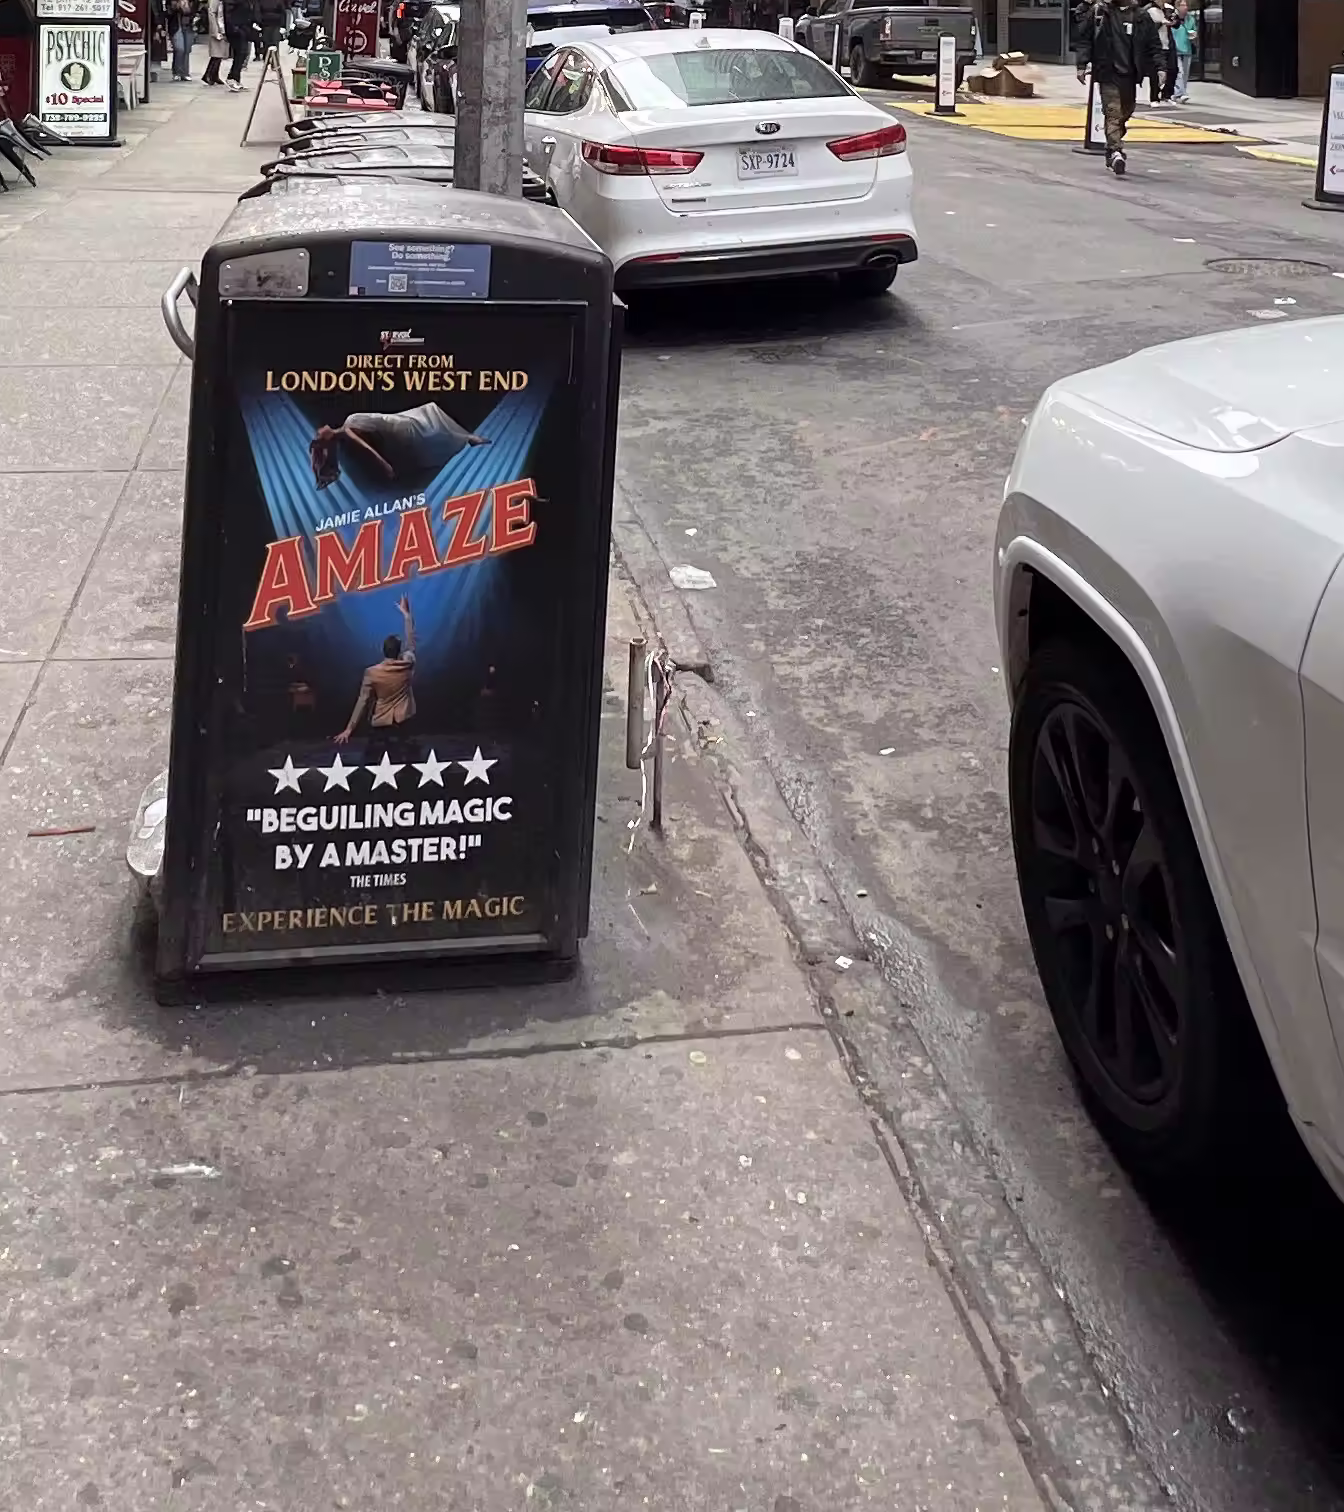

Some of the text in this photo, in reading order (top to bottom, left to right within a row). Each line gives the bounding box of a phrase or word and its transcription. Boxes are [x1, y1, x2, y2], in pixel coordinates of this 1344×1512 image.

[46, 30, 106, 67] PSYCHIC
[71, 94, 105, 105] Special
[346, 354, 454, 369] DIRECT FROM
[265, 370, 529, 392] LONDON'S WEST END
[314, 491, 427, 533] JAMIE ALLAN'S
[242, 477, 539, 633] AMAZE
[246, 795, 513, 833] "BEGUILING MAGIC
[274, 833, 482, 871] BY A MASTER!"
[350, 872, 407, 888] THE TIMES
[222, 894, 526, 934] EXPERIENCE THE MAGIC
